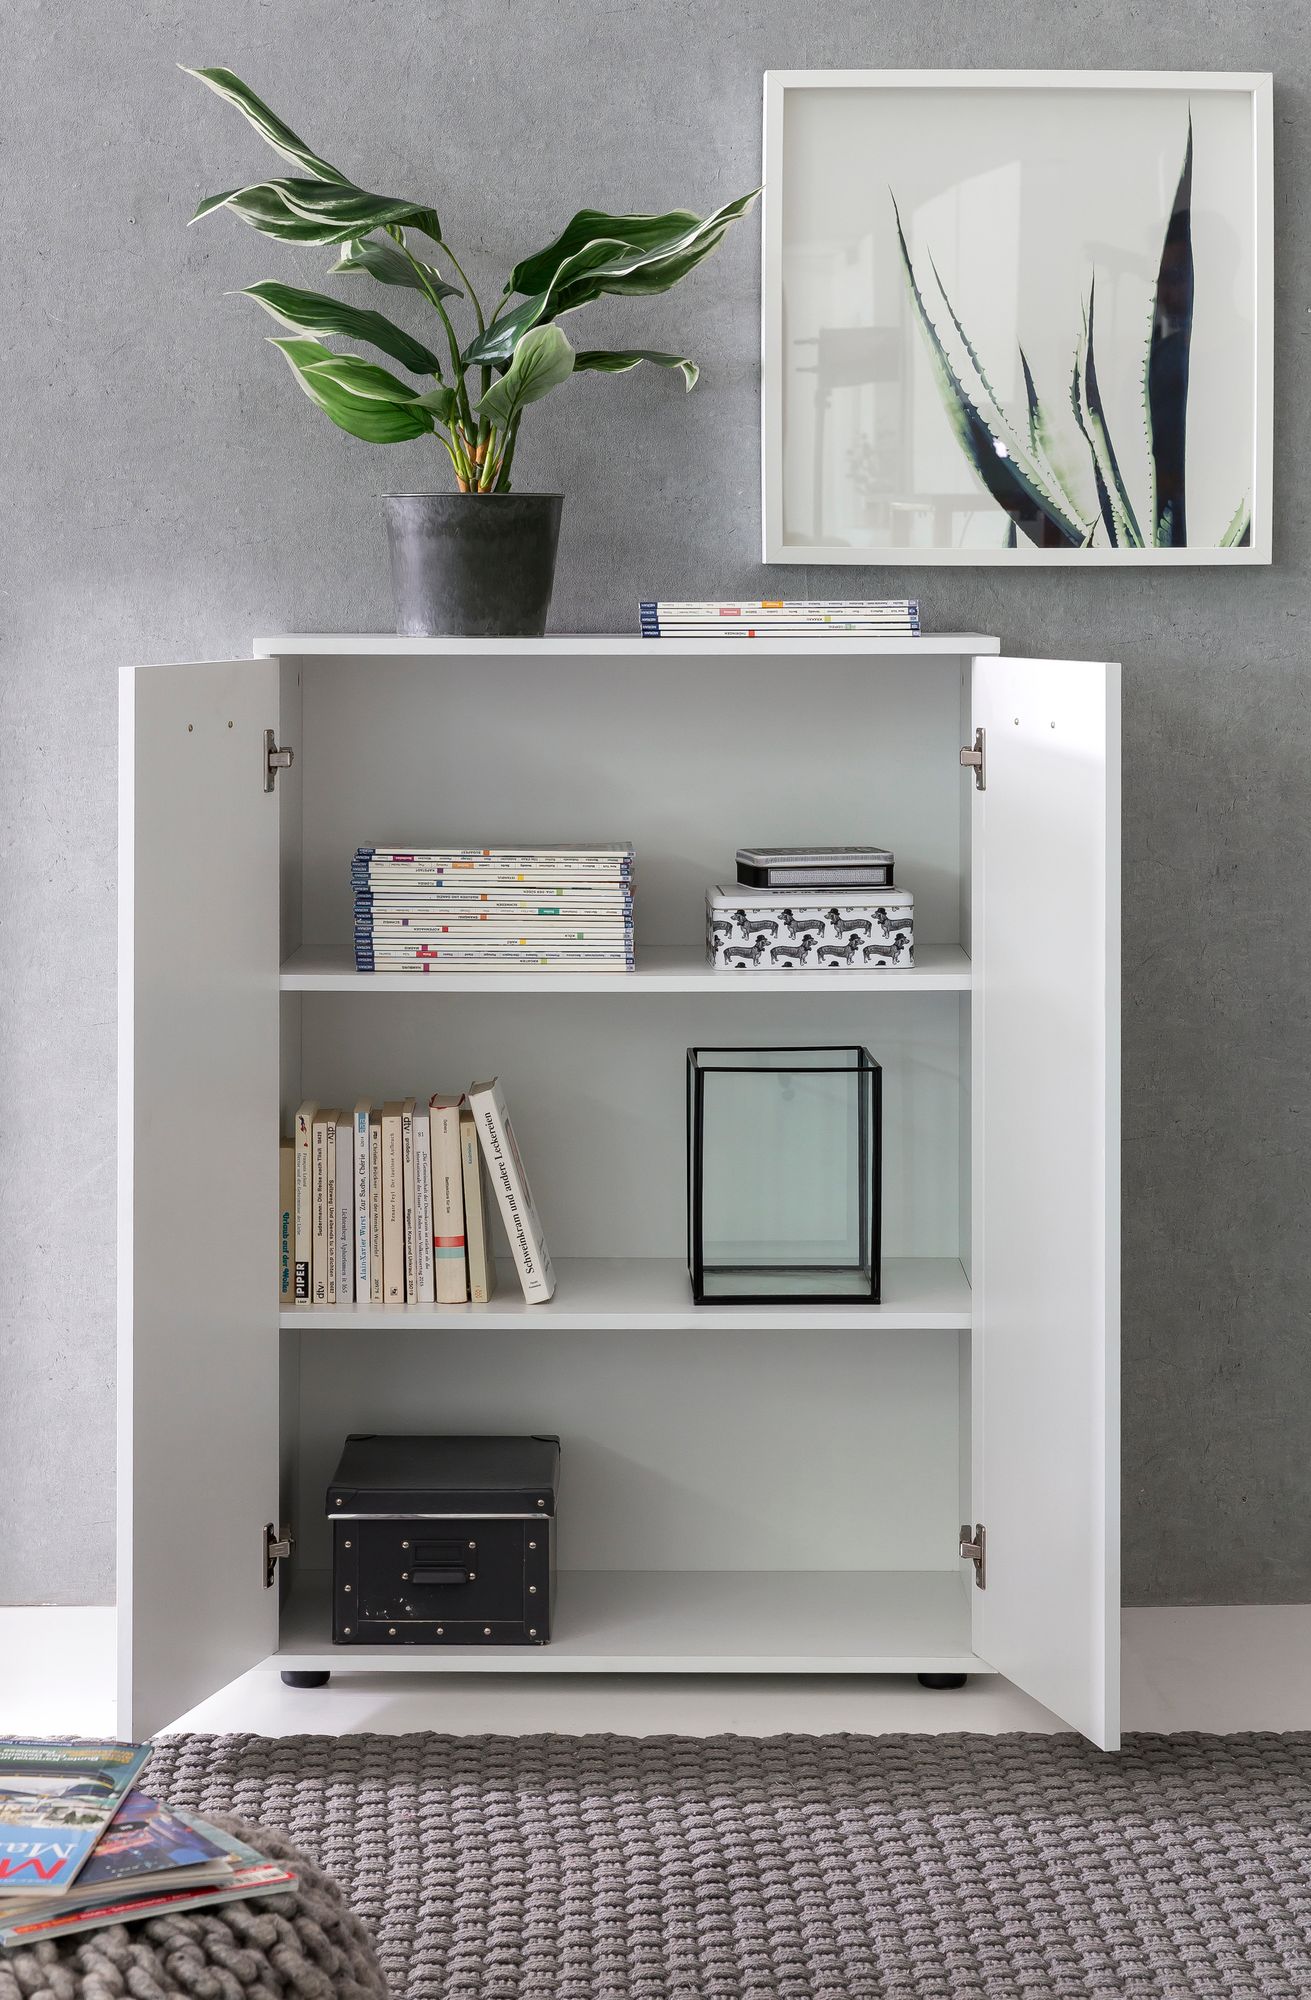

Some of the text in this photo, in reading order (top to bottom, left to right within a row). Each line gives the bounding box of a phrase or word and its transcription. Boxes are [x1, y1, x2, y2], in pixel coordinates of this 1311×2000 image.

[327, 1126, 335, 1141] dtv
[403, 1116, 412, 1164] dtv großdruck
[483, 1112, 504, 1161] Leckereien
[358, 1153, 366, 1175] Chérie
[498, 1162, 513, 1192] andere
[358, 1176, 367, 1198] Sache,
[505, 1193, 518, 1212] und
[281, 1212, 290, 1239] Urlaub
[339, 1208, 348, 1241] Lichtenberg
[359, 1215, 367, 1237] Wurst
[512, 1213, 536, 1274] Schweinkram
[340, 1242, 348, 1276] Aphorismen
[359, 1237, 367, 1281] Alain-Xavier
[281, 1268, 290, 1294] Wolke
[296, 1263, 305, 1294] PIPER
[315, 1284, 325, 1300] dtv
